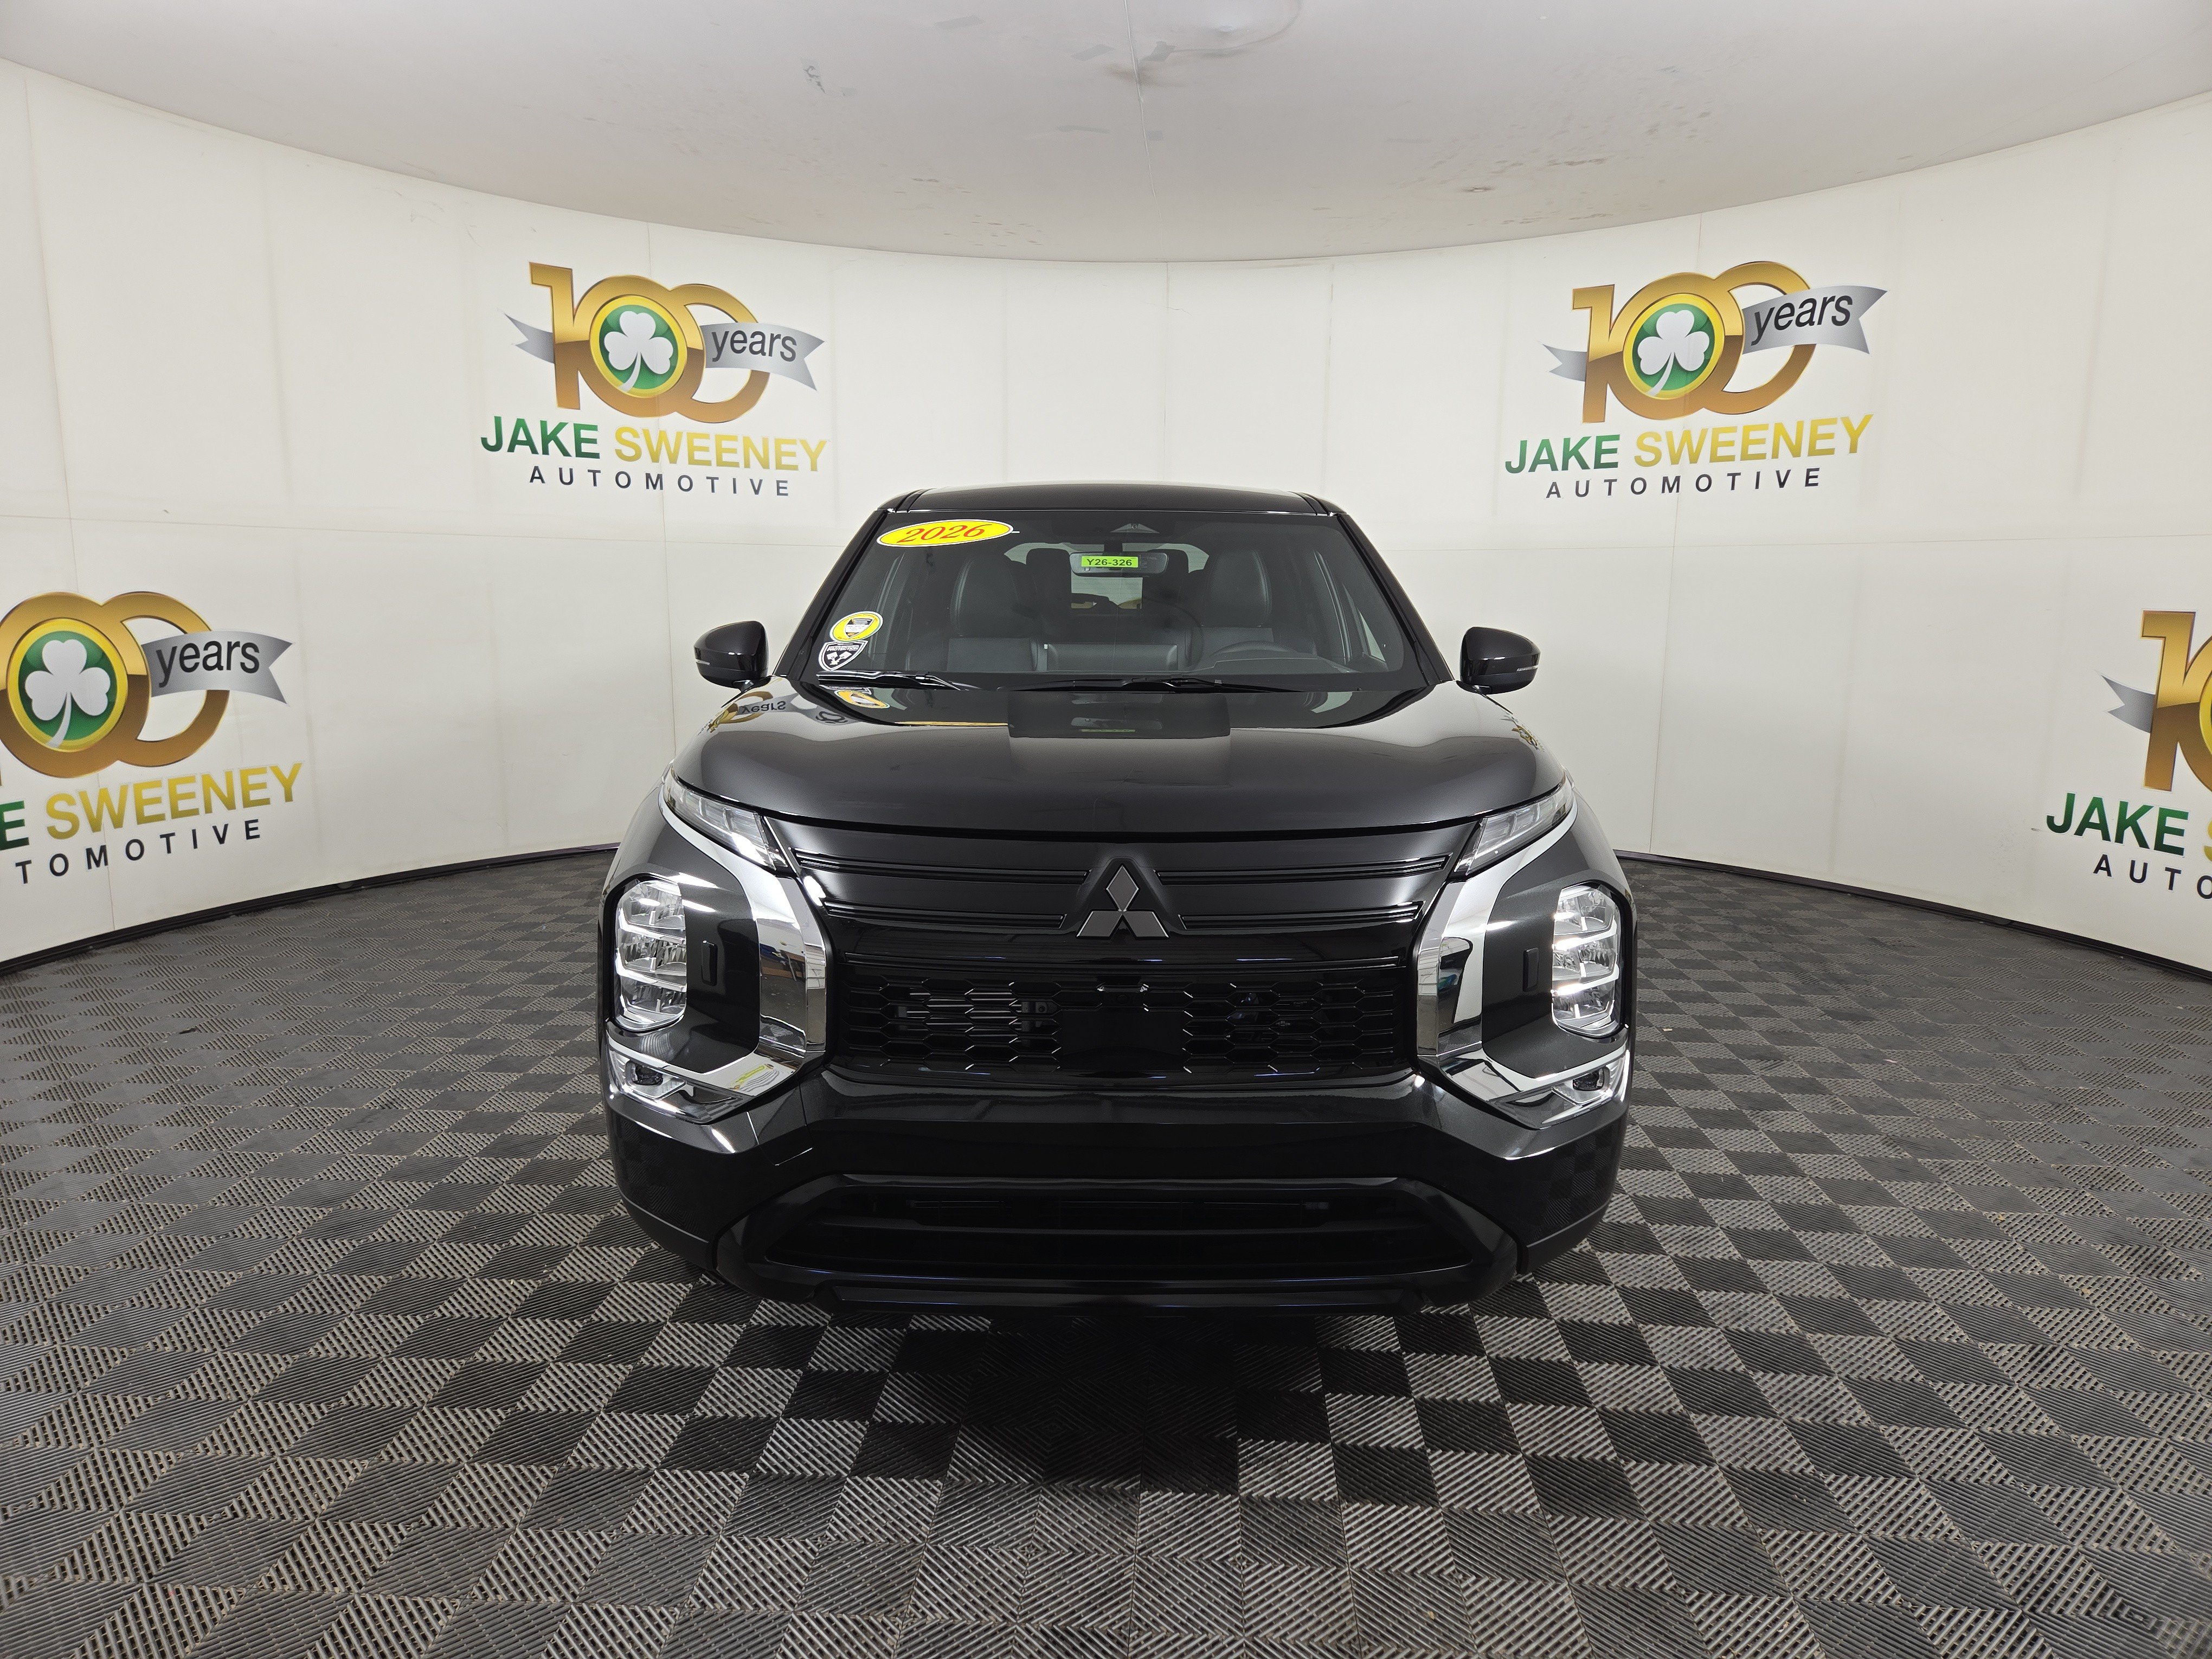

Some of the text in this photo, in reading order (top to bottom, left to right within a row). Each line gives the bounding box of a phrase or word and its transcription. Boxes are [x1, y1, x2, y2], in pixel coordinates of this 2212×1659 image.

[529, 262, 796, 423] 100 years
[1572, 261, 1853, 423] 100 years
[480, 416, 827, 472] JAKE SWEENEY
[1505, 414, 1874, 473] JAKE SWEENEY
[529, 465, 789, 497] AUTOMOTIVE
[1546, 467, 1820, 498] AUTOMOTIVE
[896, 524, 992, 543] 2026
[156, 640, 260, 688] years
[46, 762, 303, 840] SWEENEY
[2046, 792, 2189, 856] JAKE
[15, 818, 261, 884] TOMOTIVE
[2093, 854, 2212, 899] AUTO
